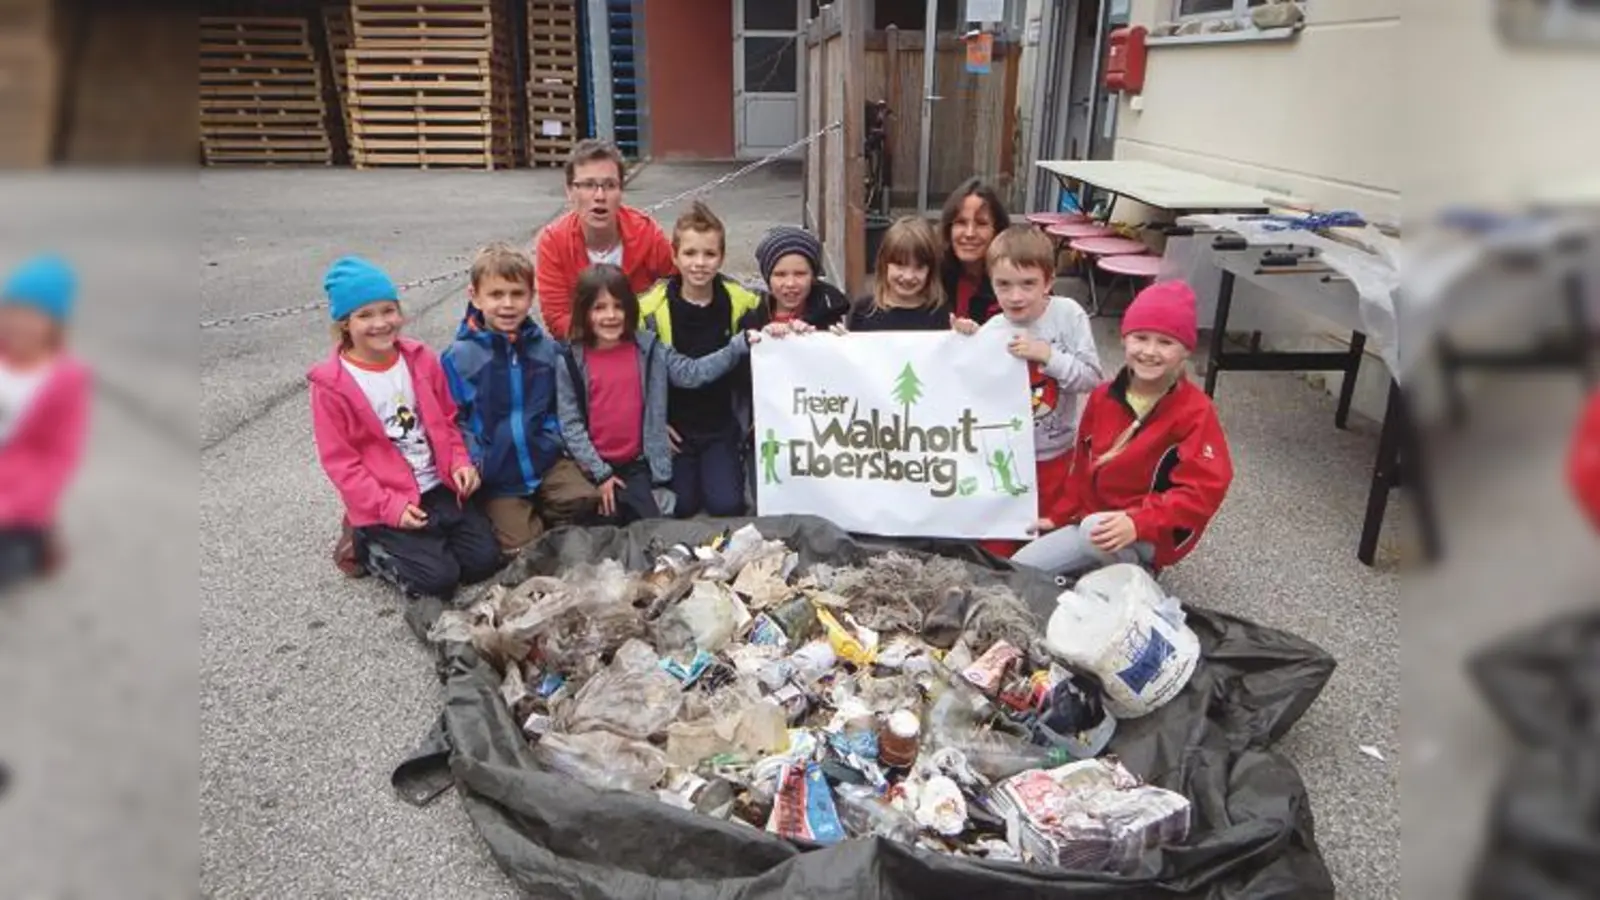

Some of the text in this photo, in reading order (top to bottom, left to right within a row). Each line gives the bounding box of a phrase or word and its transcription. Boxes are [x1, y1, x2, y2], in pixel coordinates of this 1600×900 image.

[793, 387, 848, 414] Freier
[810, 399, 978, 453] Waldhort
[789, 439, 957, 498] Ebersberg
